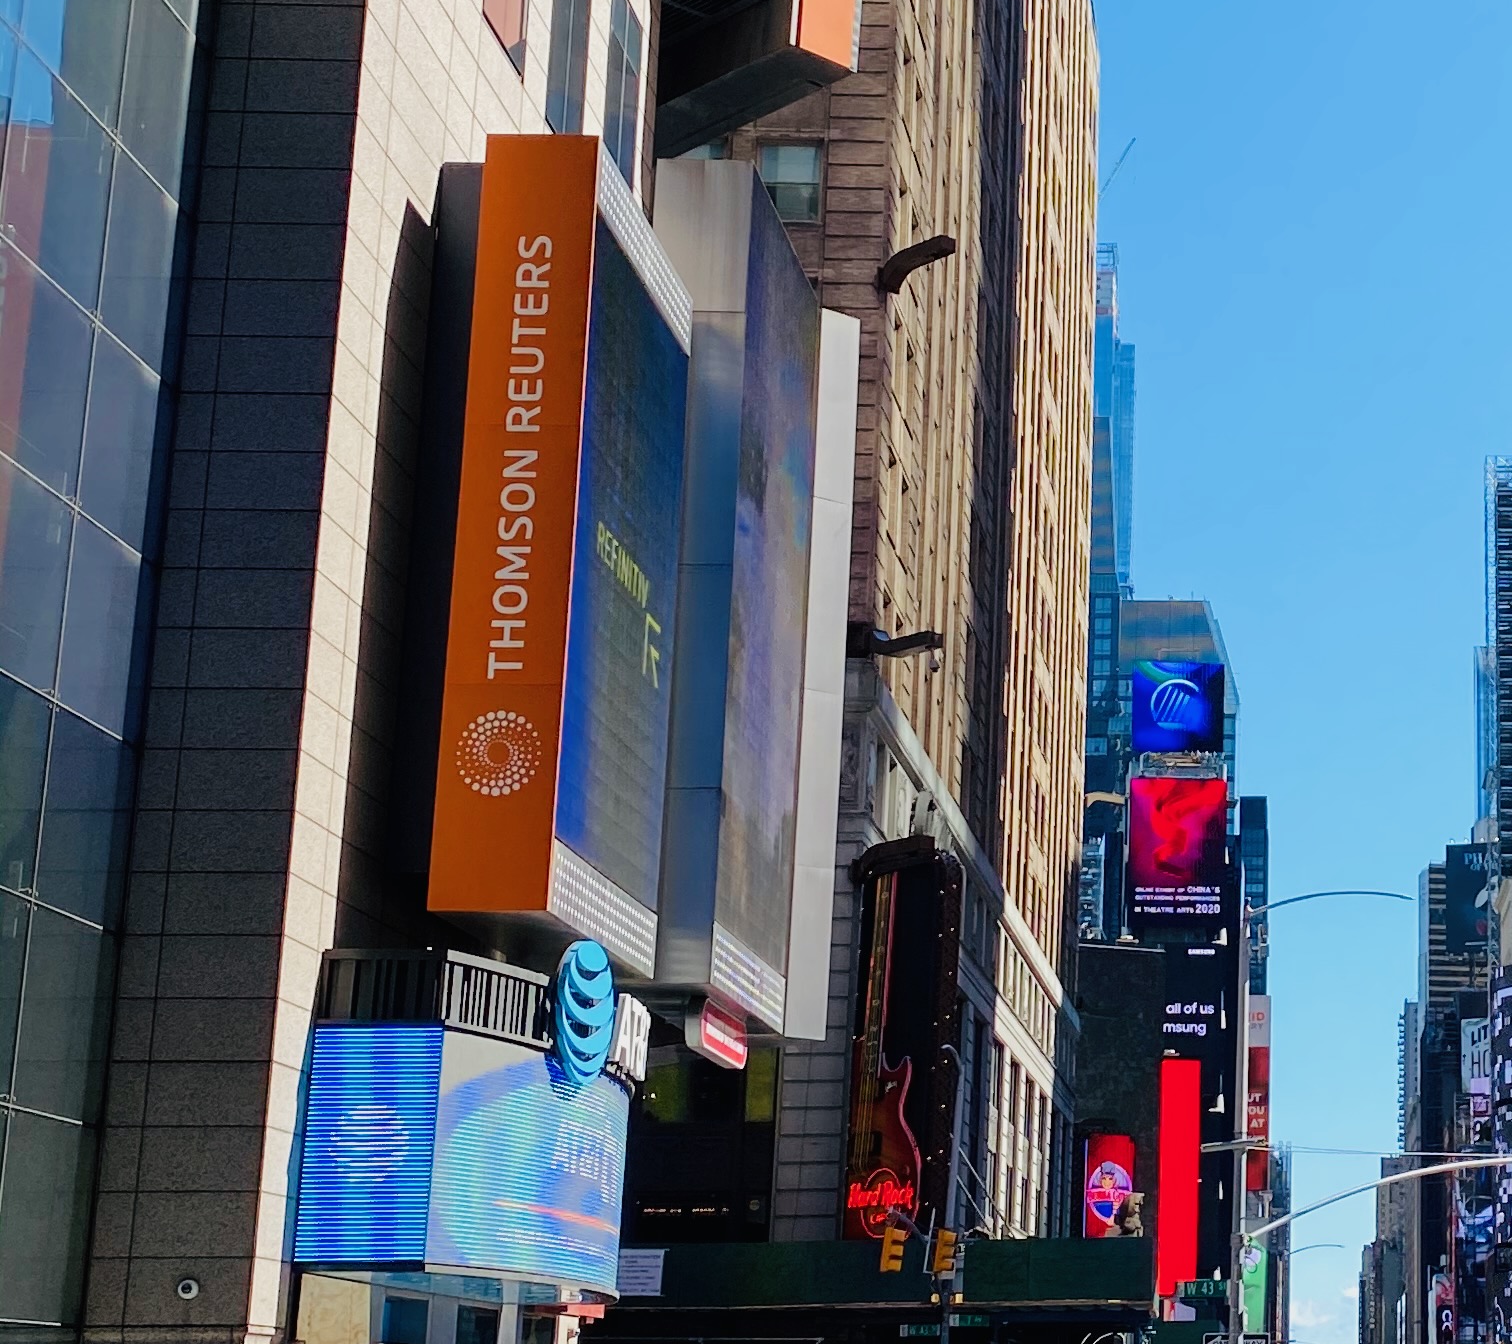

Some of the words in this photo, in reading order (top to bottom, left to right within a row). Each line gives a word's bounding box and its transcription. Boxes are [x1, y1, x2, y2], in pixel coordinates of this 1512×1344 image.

[505, 233, 553, 433] REUTERS
[486, 449, 539, 680] THOMSON
[597, 521, 650, 609] REFINITIV
[1187, 885, 1221, 894] CHINA'S
[1143, 905, 1175, 913] THEATRE
[1195, 903, 1221, 914] 2020
[1165, 1002, 1181, 1015] all
[1183, 1001, 1198, 1015] of
[1199, 1004, 1215, 1015] us
[848, 1182, 882, 1209] Hard
[881, 1180, 914, 1210] Rock
[1186, 1282, 1196, 1295] W
[1200, 1282, 1214, 1296] 43
